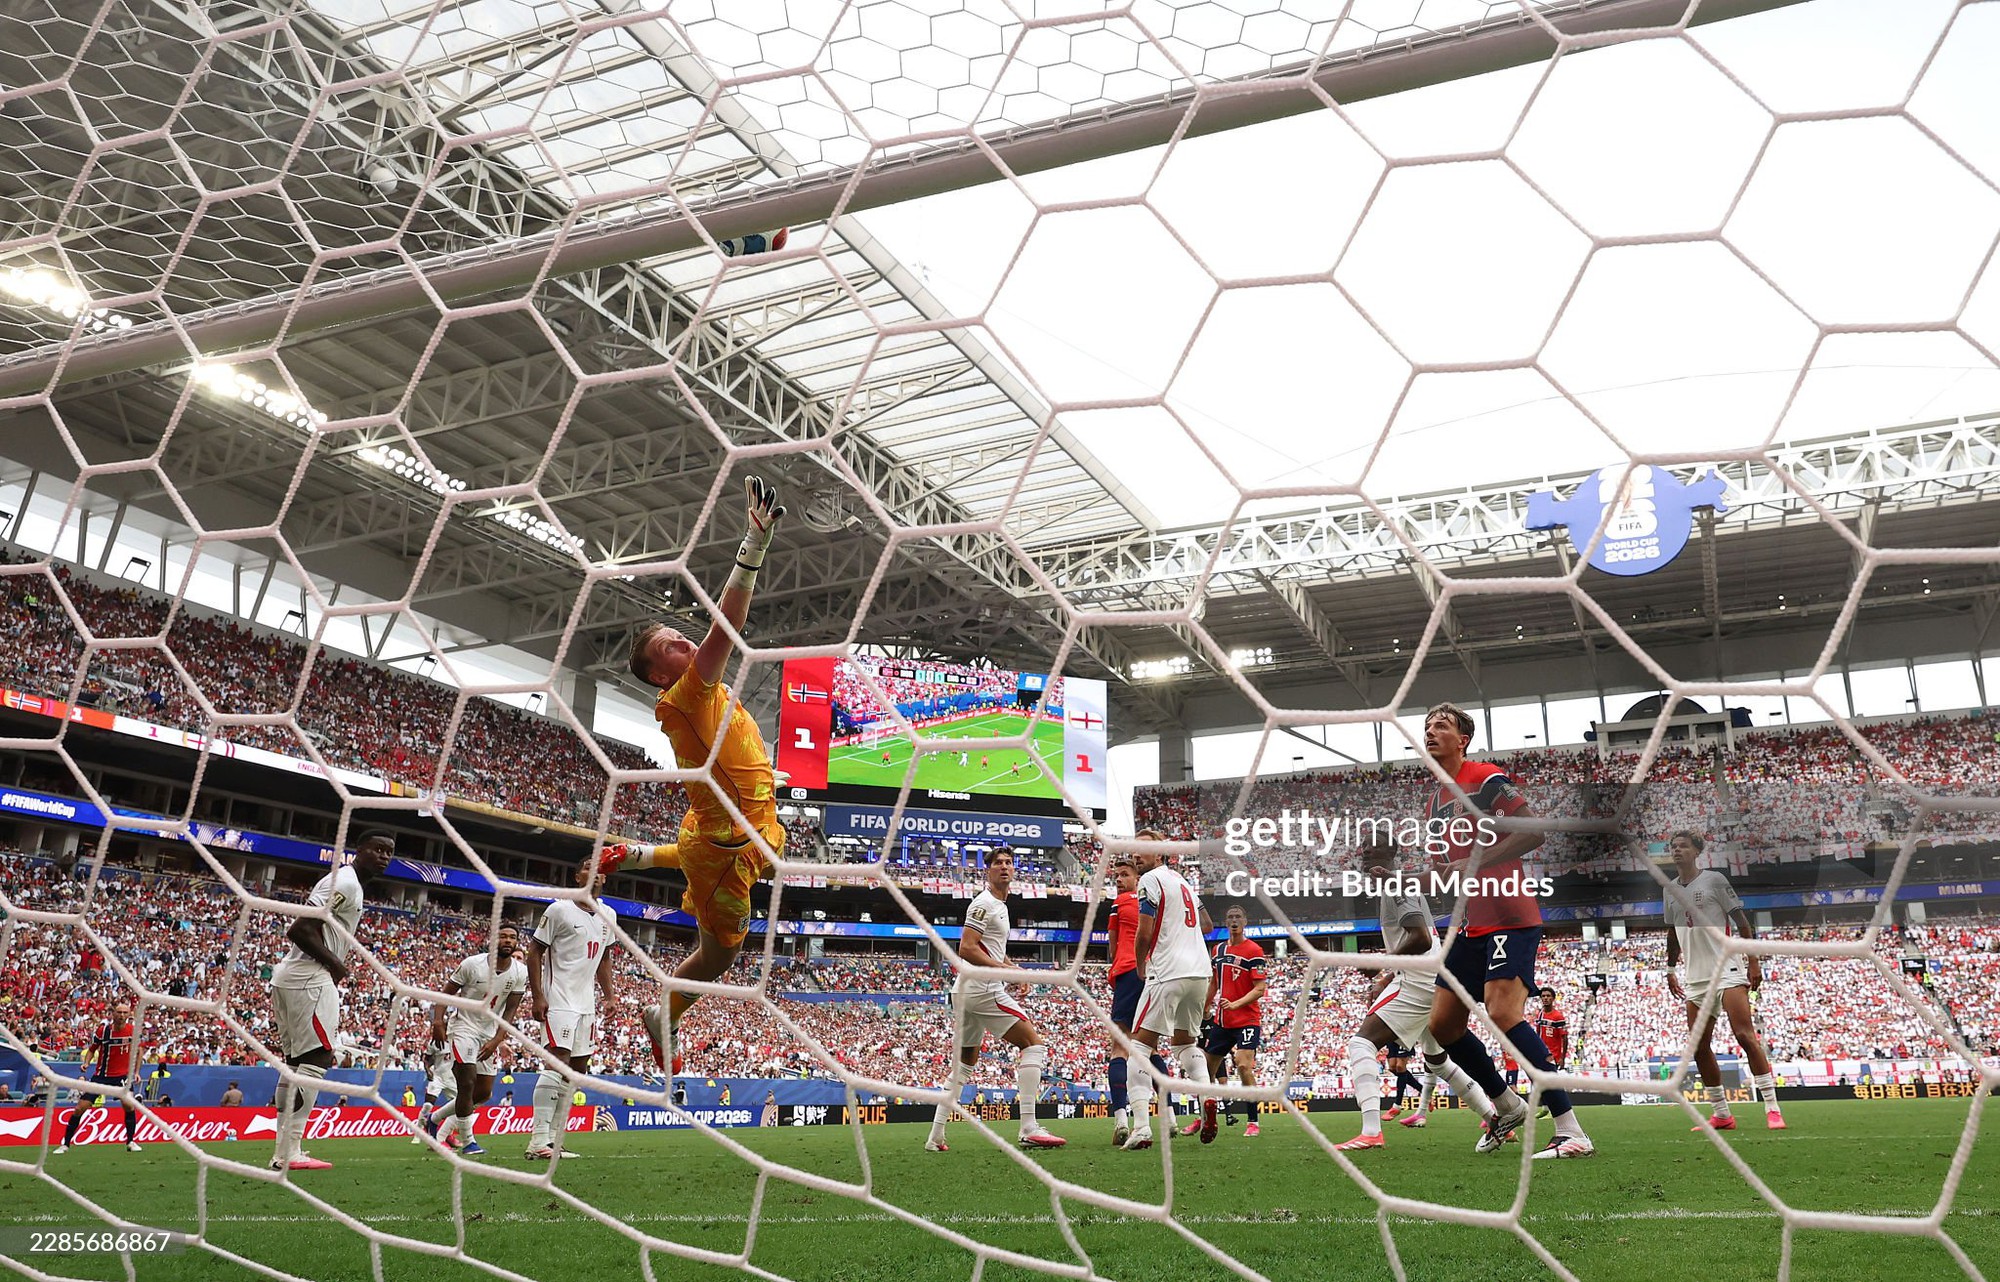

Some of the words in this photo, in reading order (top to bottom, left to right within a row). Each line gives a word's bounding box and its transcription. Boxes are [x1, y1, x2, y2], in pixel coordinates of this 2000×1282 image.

[1619, 522, 1642, 531] FIFA
[1604, 539, 1639, 551] WORLD
[1639, 537, 1659, 547] CUP
[1605, 546, 1660, 563] 2026
[71, 707, 83, 721] 1
[148, 727, 158, 738] 1
[795, 727, 815, 749] 1
[1076, 754, 1093, 772] 1
[792, 790, 807, 798] CC
[928, 789, 971, 800] Hisense
[2, 793, 76, 818] #FIFAWorldCup
[850, 814, 887, 829] FIFA
[951, 820, 984, 835] CUP
[986, 822, 1042, 837] 2026
[1939, 884, 1983, 896] MIAMI
[1180, 884, 1197, 928] 9
[1685, 911, 1694, 928] 3
[587, 941, 600, 960] 10
[1492, 935, 1508, 960] 8
[1242, 1027, 1255, 1040] 17
[1853, 1084, 1917, 1099] 每日蛋白
[628, 1111, 653, 1126] FIFA
[715, 1110, 747, 1123] 2026
[806, 1105, 828, 1125] 蒙牛
[982, 1105, 1011, 1121] 自在状态
